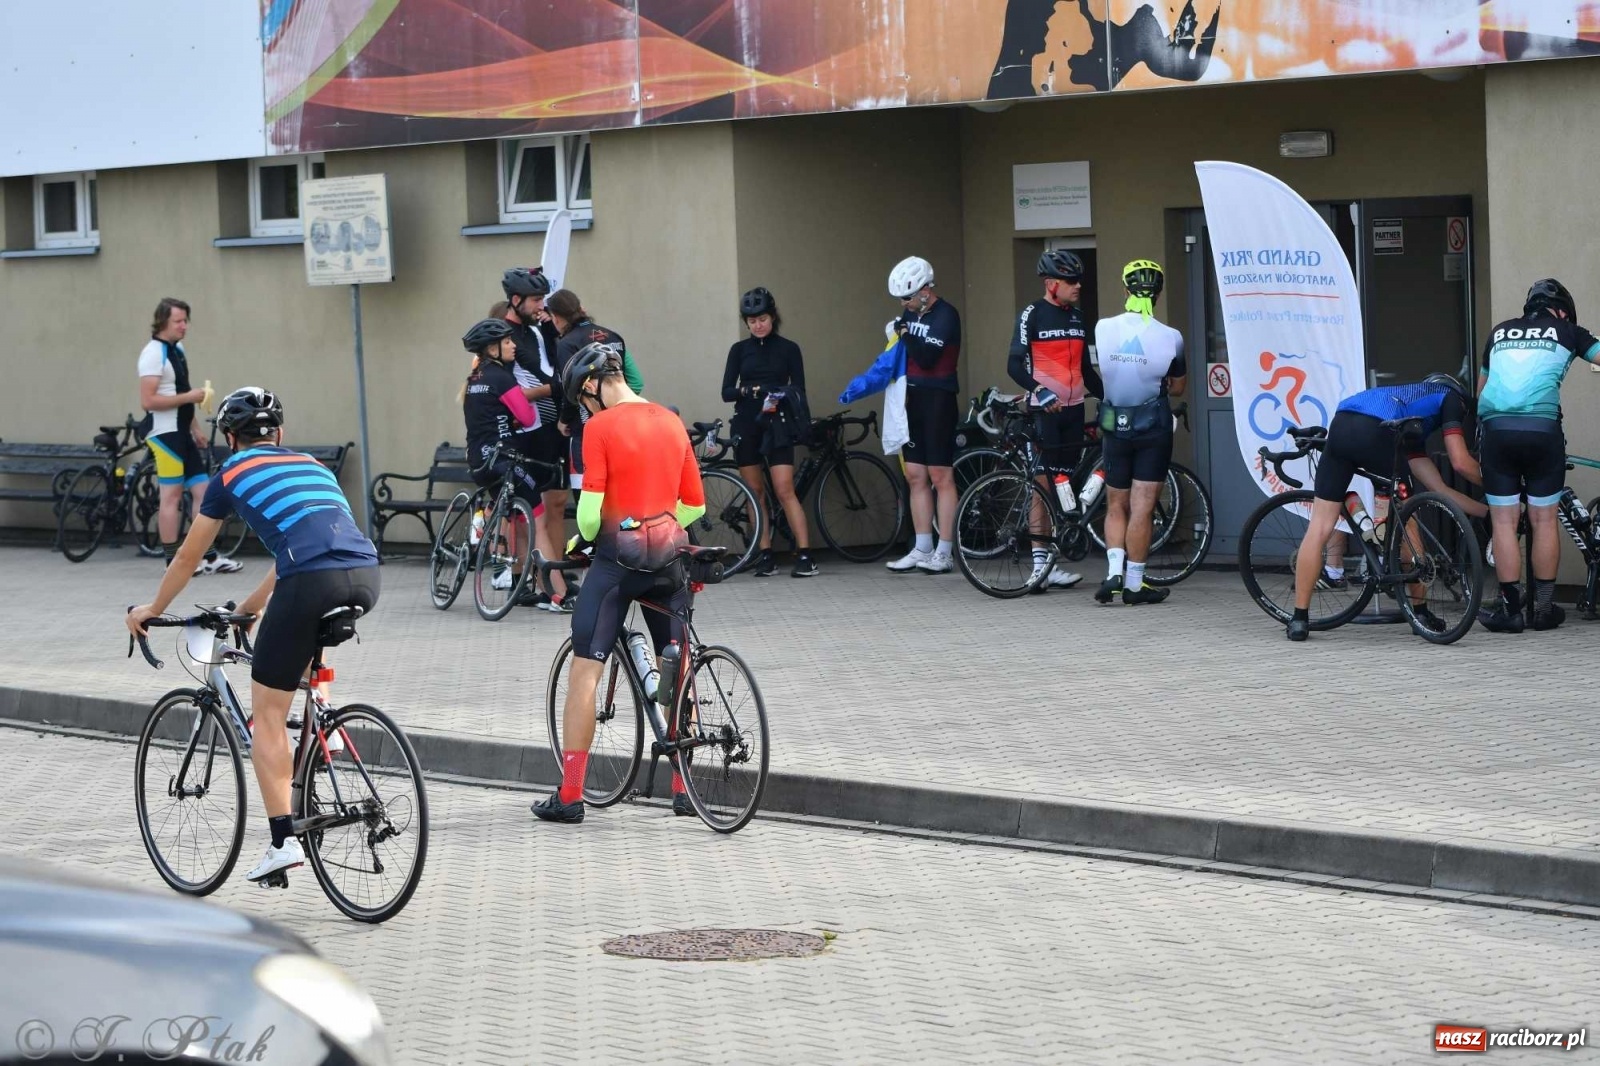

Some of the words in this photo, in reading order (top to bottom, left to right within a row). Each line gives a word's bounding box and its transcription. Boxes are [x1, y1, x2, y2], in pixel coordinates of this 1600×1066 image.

[1375, 231, 1401, 240] PARTNER
[1020, 304, 1036, 346] DAR-BUD
[1493, 326, 1559, 343] BORA
[1495, 339, 1553, 351] hansgrohe
